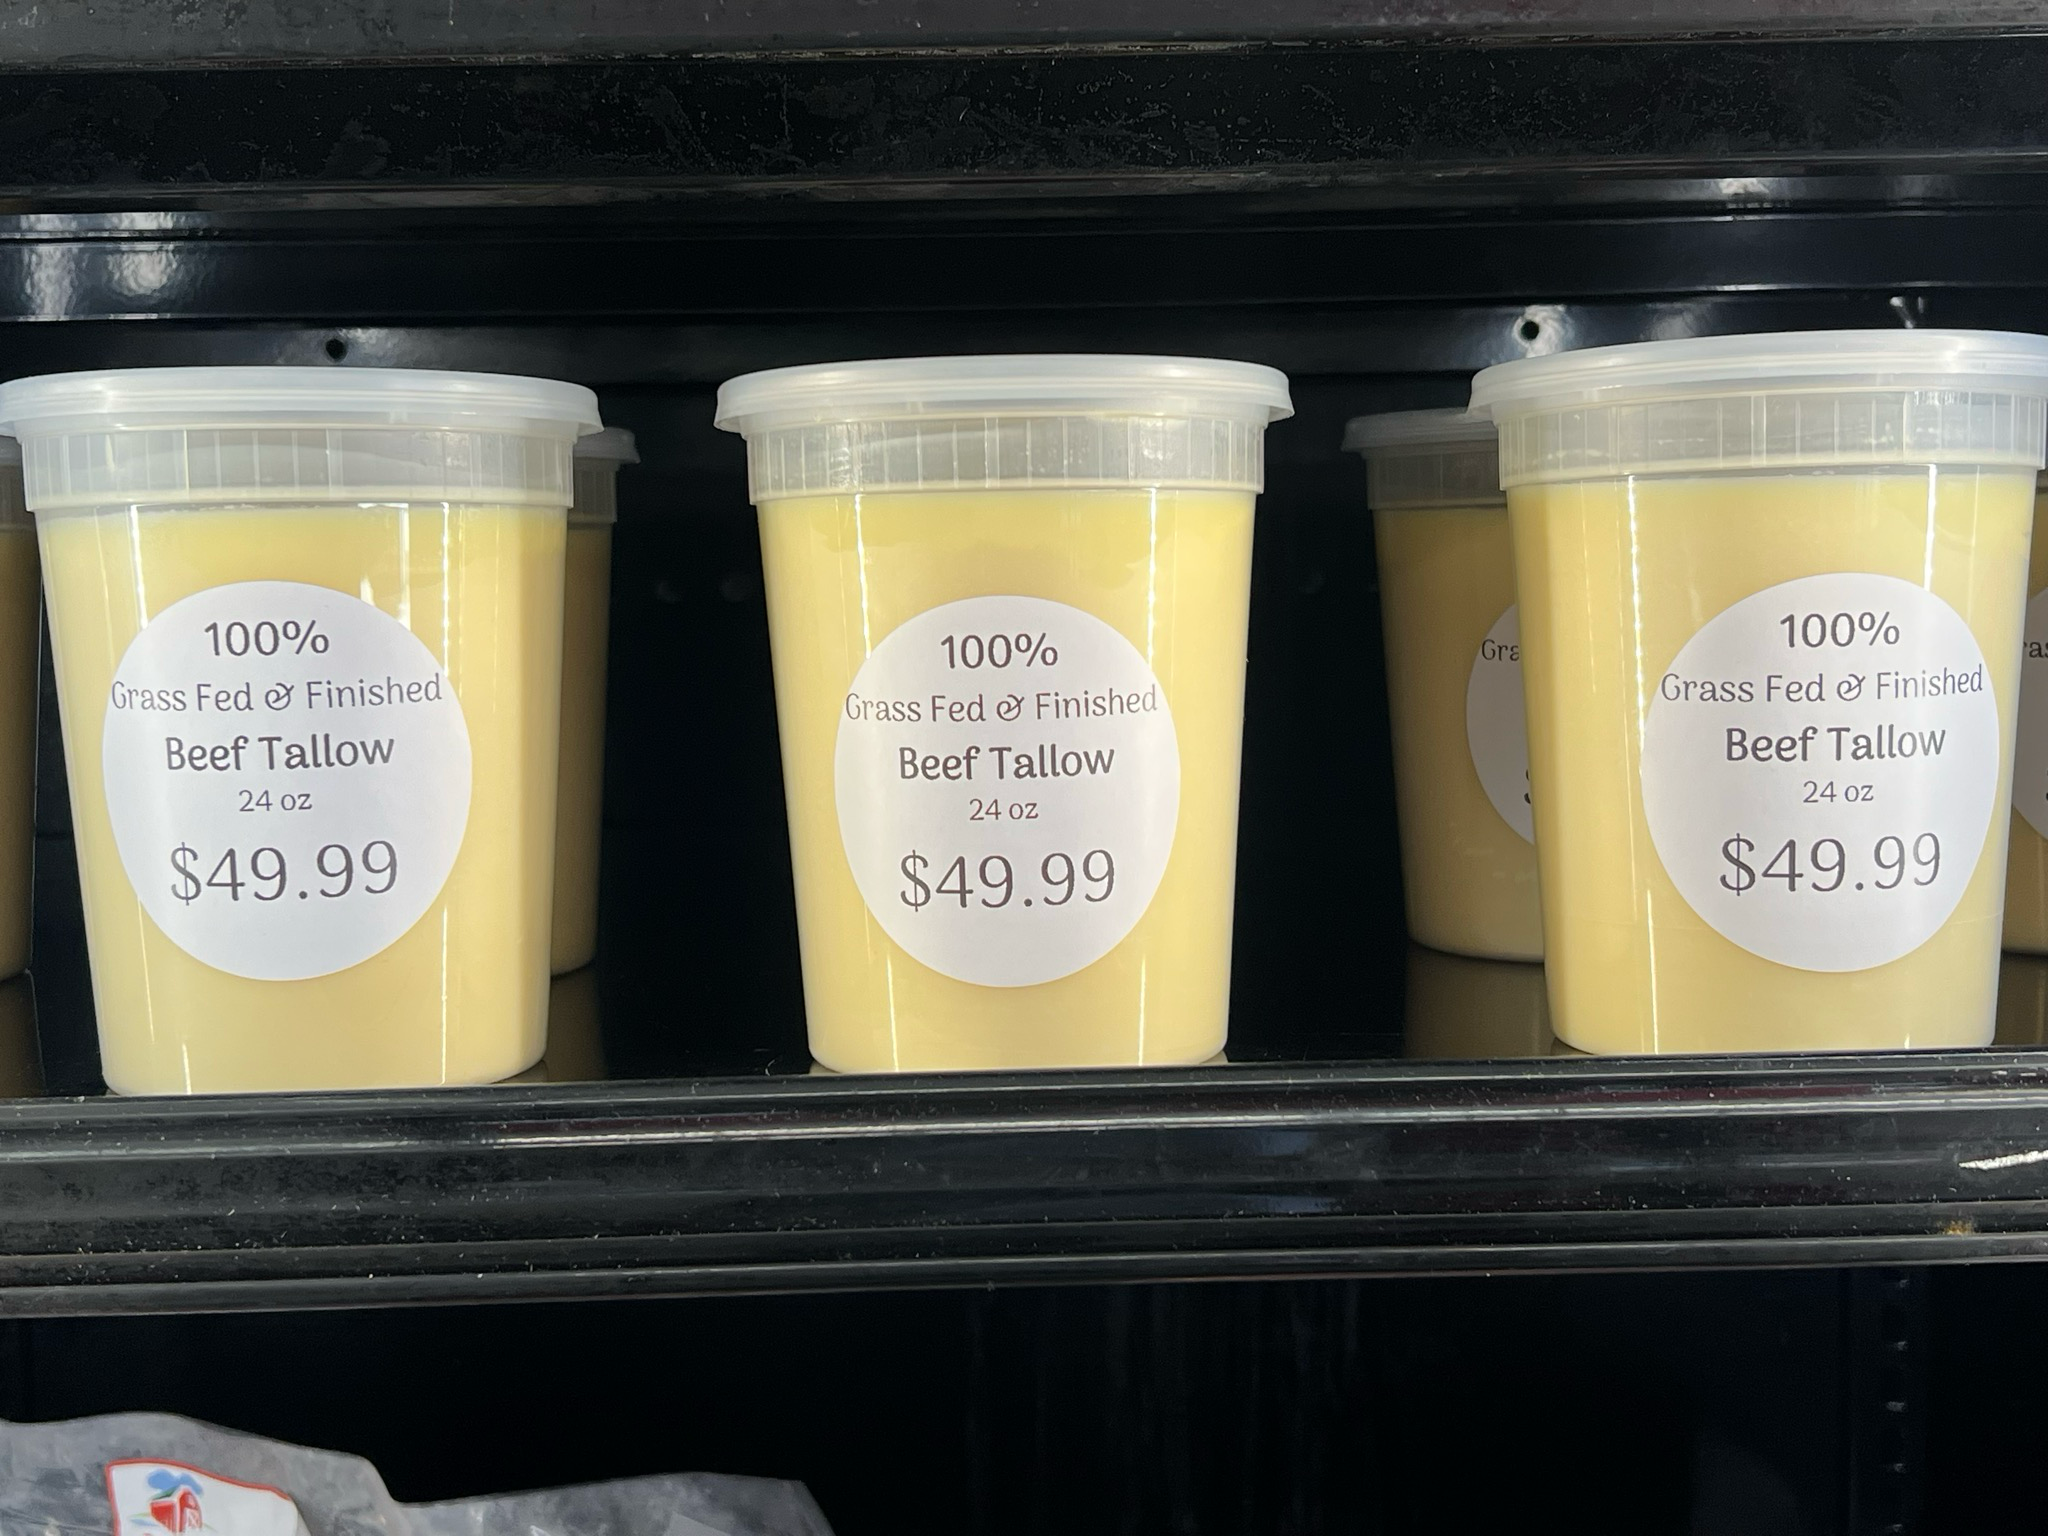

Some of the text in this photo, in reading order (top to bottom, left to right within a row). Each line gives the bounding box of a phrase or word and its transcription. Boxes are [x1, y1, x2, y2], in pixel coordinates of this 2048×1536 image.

[205, 620, 329, 656] 100%
[1780, 611, 1899, 648] 100%
[941, 633, 1058, 669] 100%
[112, 673, 442, 711] Grass Fed & Finished
[1662, 664, 1982, 702] Grass Fed & Finished
[846, 684, 1157, 722] Grass Fed & Finished
[165, 733, 394, 771] Beef Tallow
[899, 743, 1114, 780] Beef Tallow
[1726, 724, 1945, 762] Beef Tallow
[239, 790, 312, 812] 24 oz
[970, 799, 1038, 820] 24 oz
[1803, 781, 1874, 803] 24 oz
[171, 841, 397, 906] $49.99
[901, 849, 1114, 912] $49.99
[1720, 833, 1940, 896] $49.99
